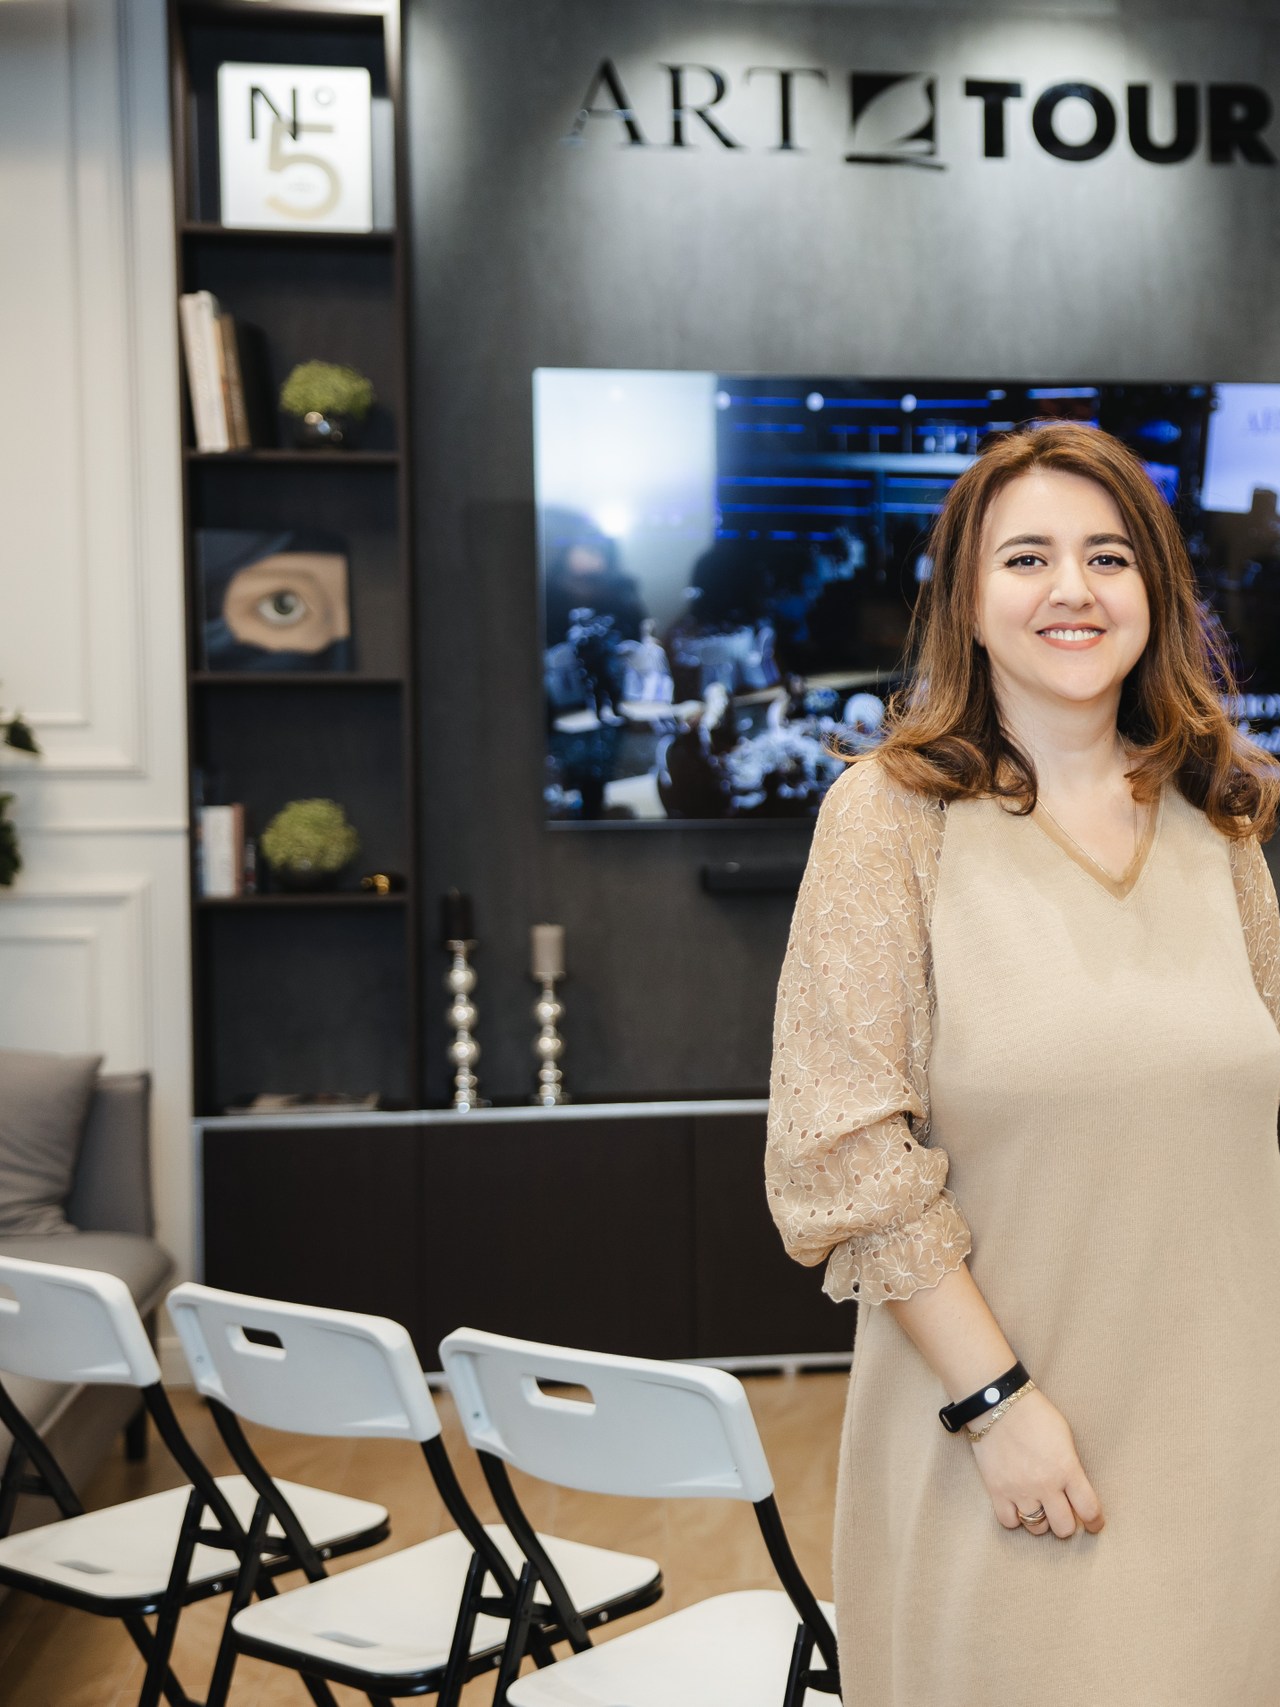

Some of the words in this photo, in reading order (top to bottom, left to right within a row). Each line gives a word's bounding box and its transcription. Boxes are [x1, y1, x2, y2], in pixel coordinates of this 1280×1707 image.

[560, 57, 831, 153] ART
[964, 77, 1277, 165] TOUR
[265, 120, 341, 222] 5
